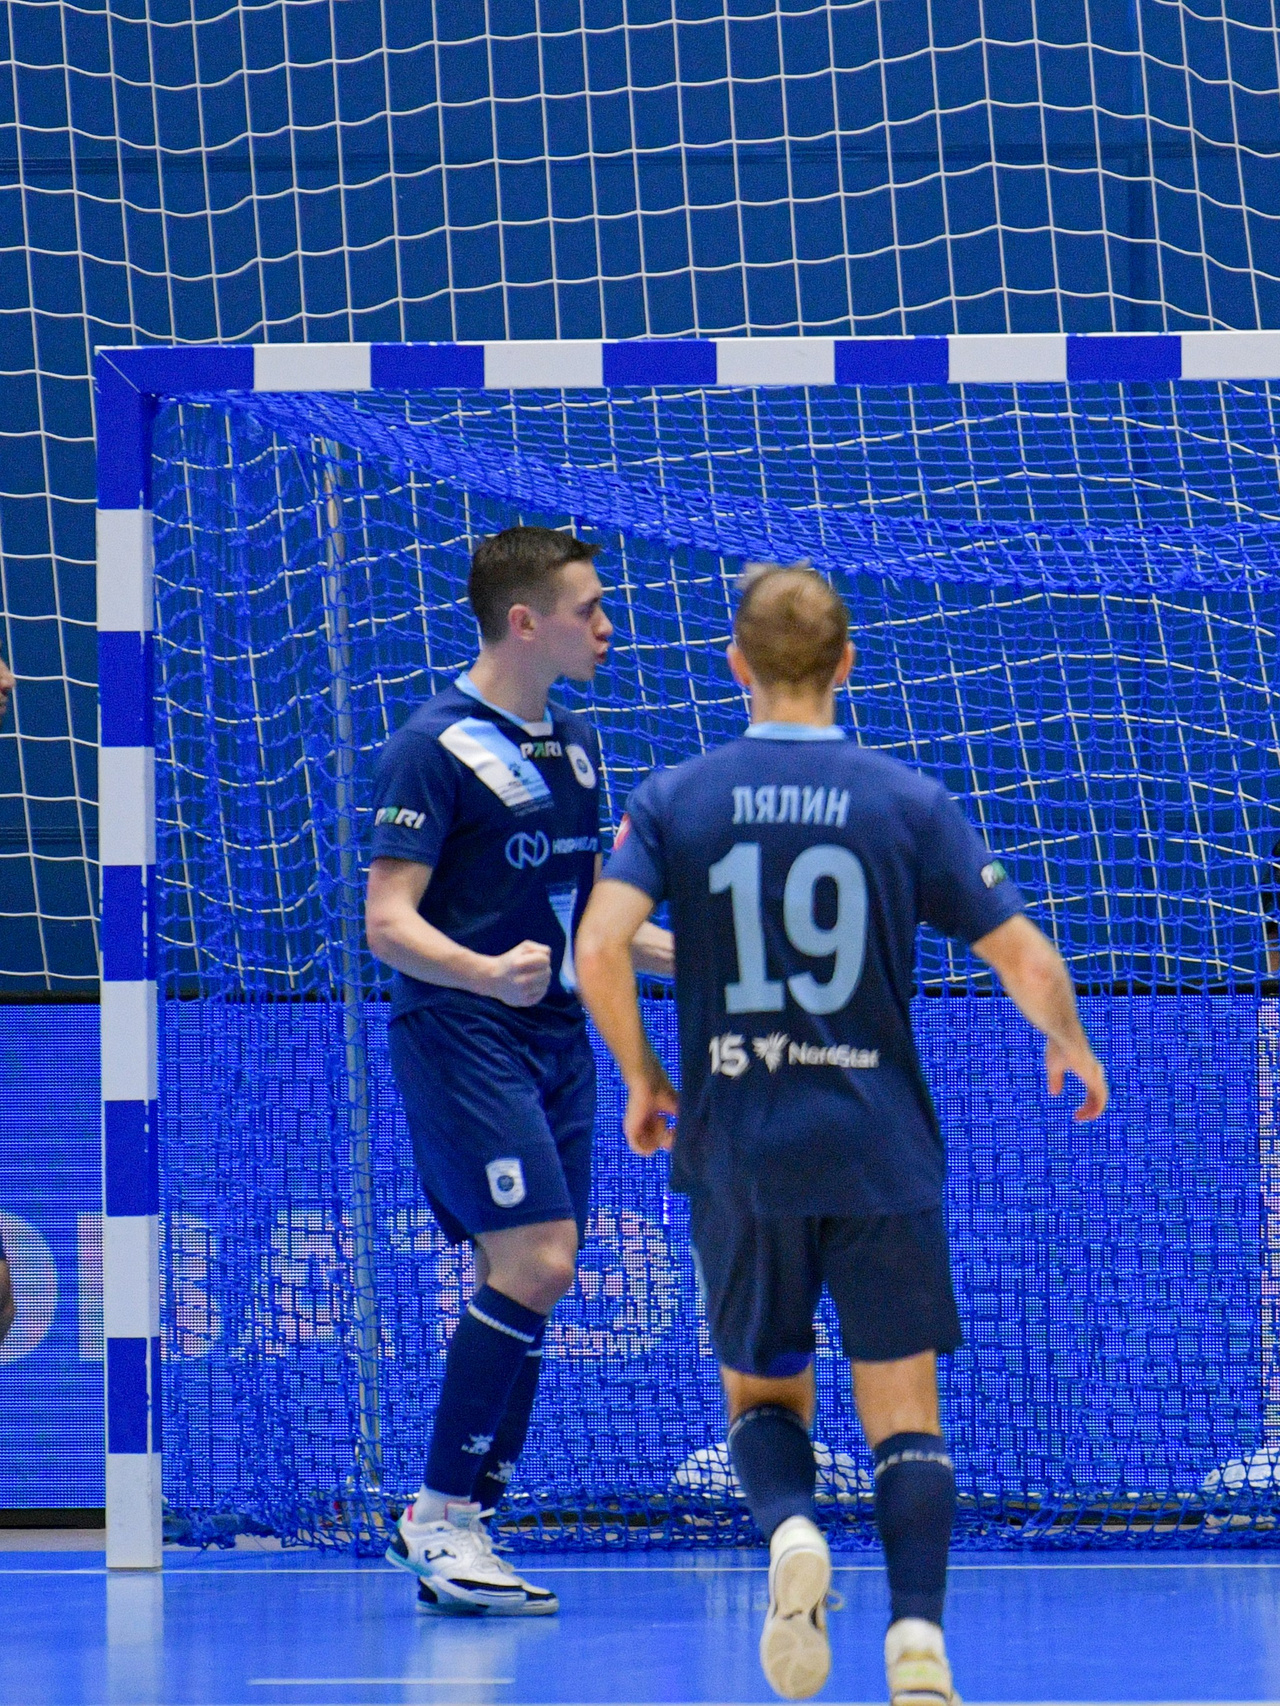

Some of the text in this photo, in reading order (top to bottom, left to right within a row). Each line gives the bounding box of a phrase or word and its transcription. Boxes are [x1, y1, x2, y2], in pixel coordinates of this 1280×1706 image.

[732, 785, 850, 828] ЛЯЛИН
[708, 842, 867, 1015] 19
[709, 1032, 750, 1078] 15
